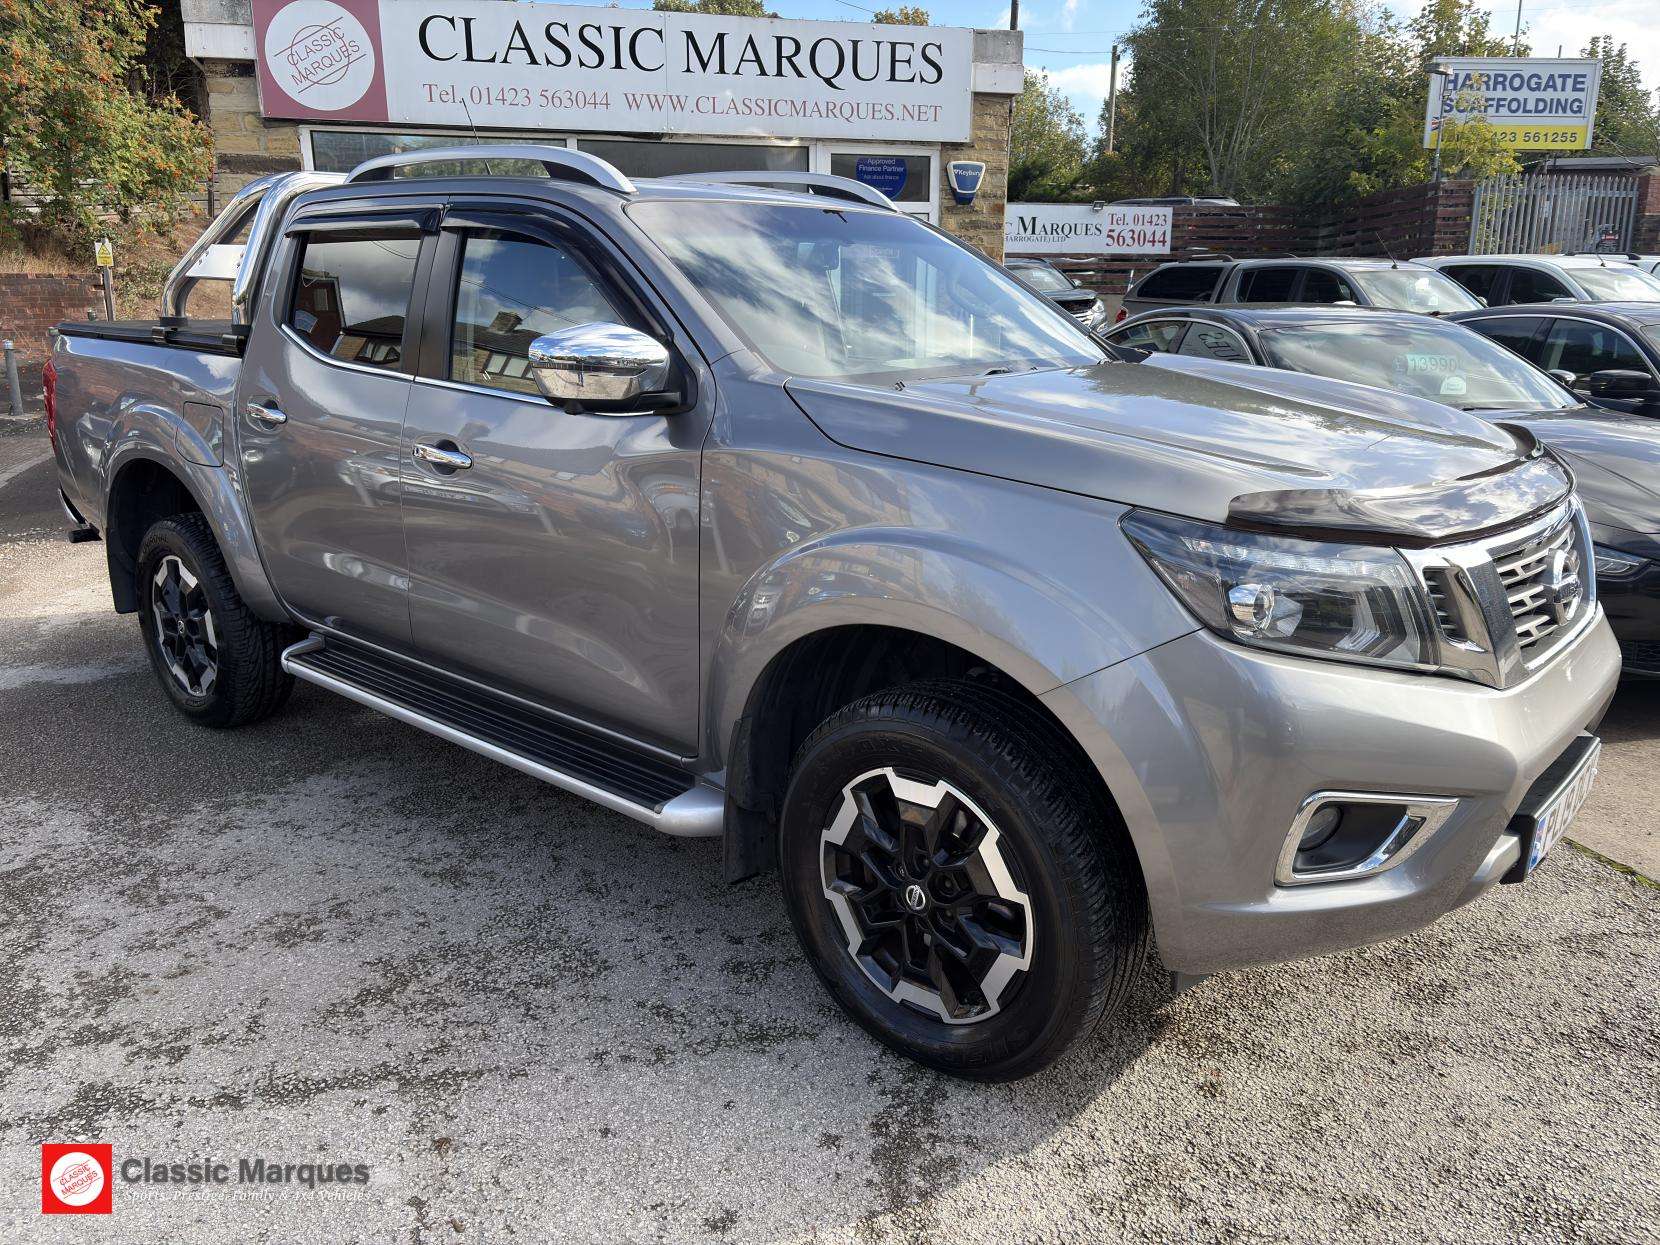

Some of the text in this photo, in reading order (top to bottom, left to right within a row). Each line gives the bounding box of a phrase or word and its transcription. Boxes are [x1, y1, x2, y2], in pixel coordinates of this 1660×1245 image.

[286, 26, 346, 67] CLASSIC
[418, 14, 944, 91] CLASSIC MARQUES
[291, 40, 361, 86] MARQUES
[423, 83, 943, 124] Tel. 01423 563044 WWW.CLASSICMARQUES.NET
[1522, 131, 1578, 143] 561255
[1016, 216, 1103, 238] MARQUES
[1108, 212, 1167, 227] Tel. 01423
[1105, 228, 1168, 247] 563044
